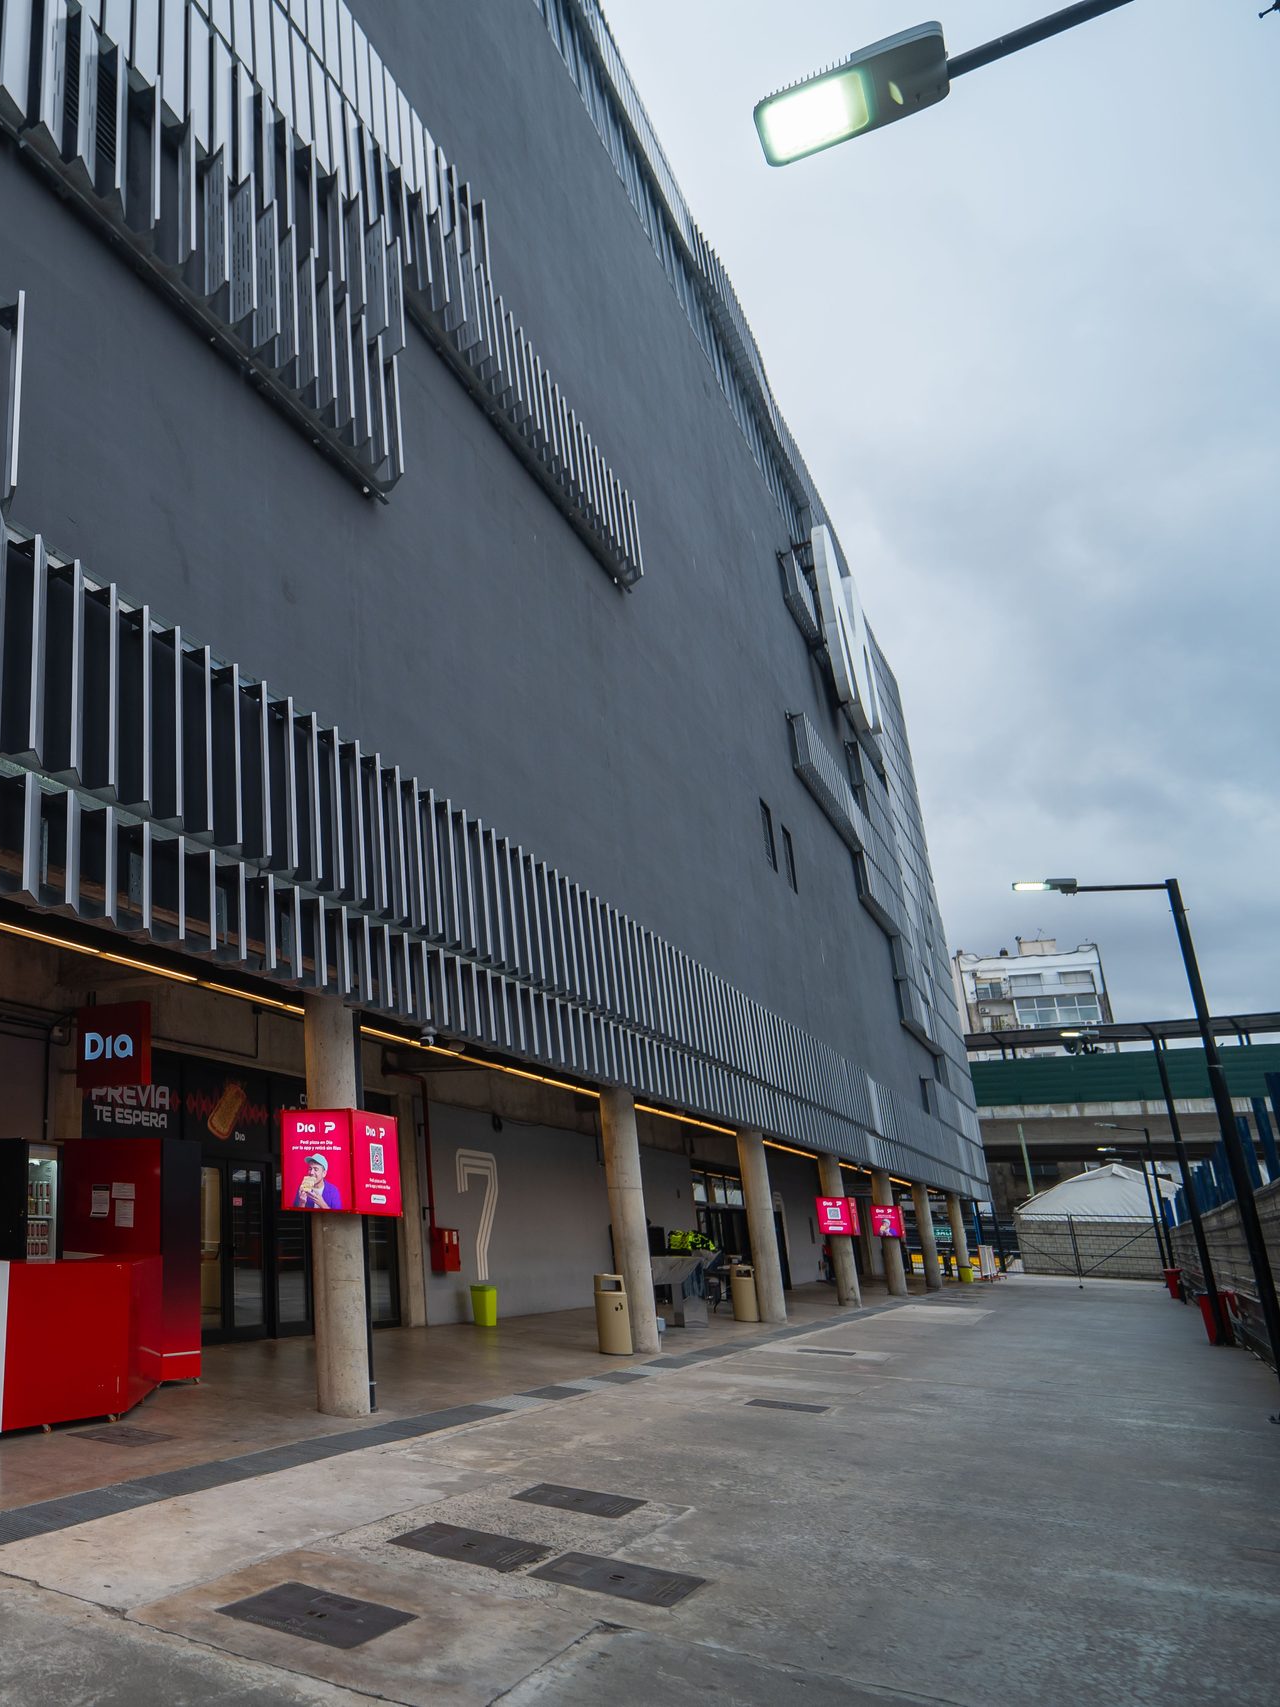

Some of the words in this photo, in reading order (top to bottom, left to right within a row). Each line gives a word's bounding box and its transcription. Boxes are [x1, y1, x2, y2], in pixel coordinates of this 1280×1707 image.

[91, 1084, 170, 1111] PREVIA
[93, 1105, 113, 1123] TE
[115, 1110, 168, 1129] ESPERA
